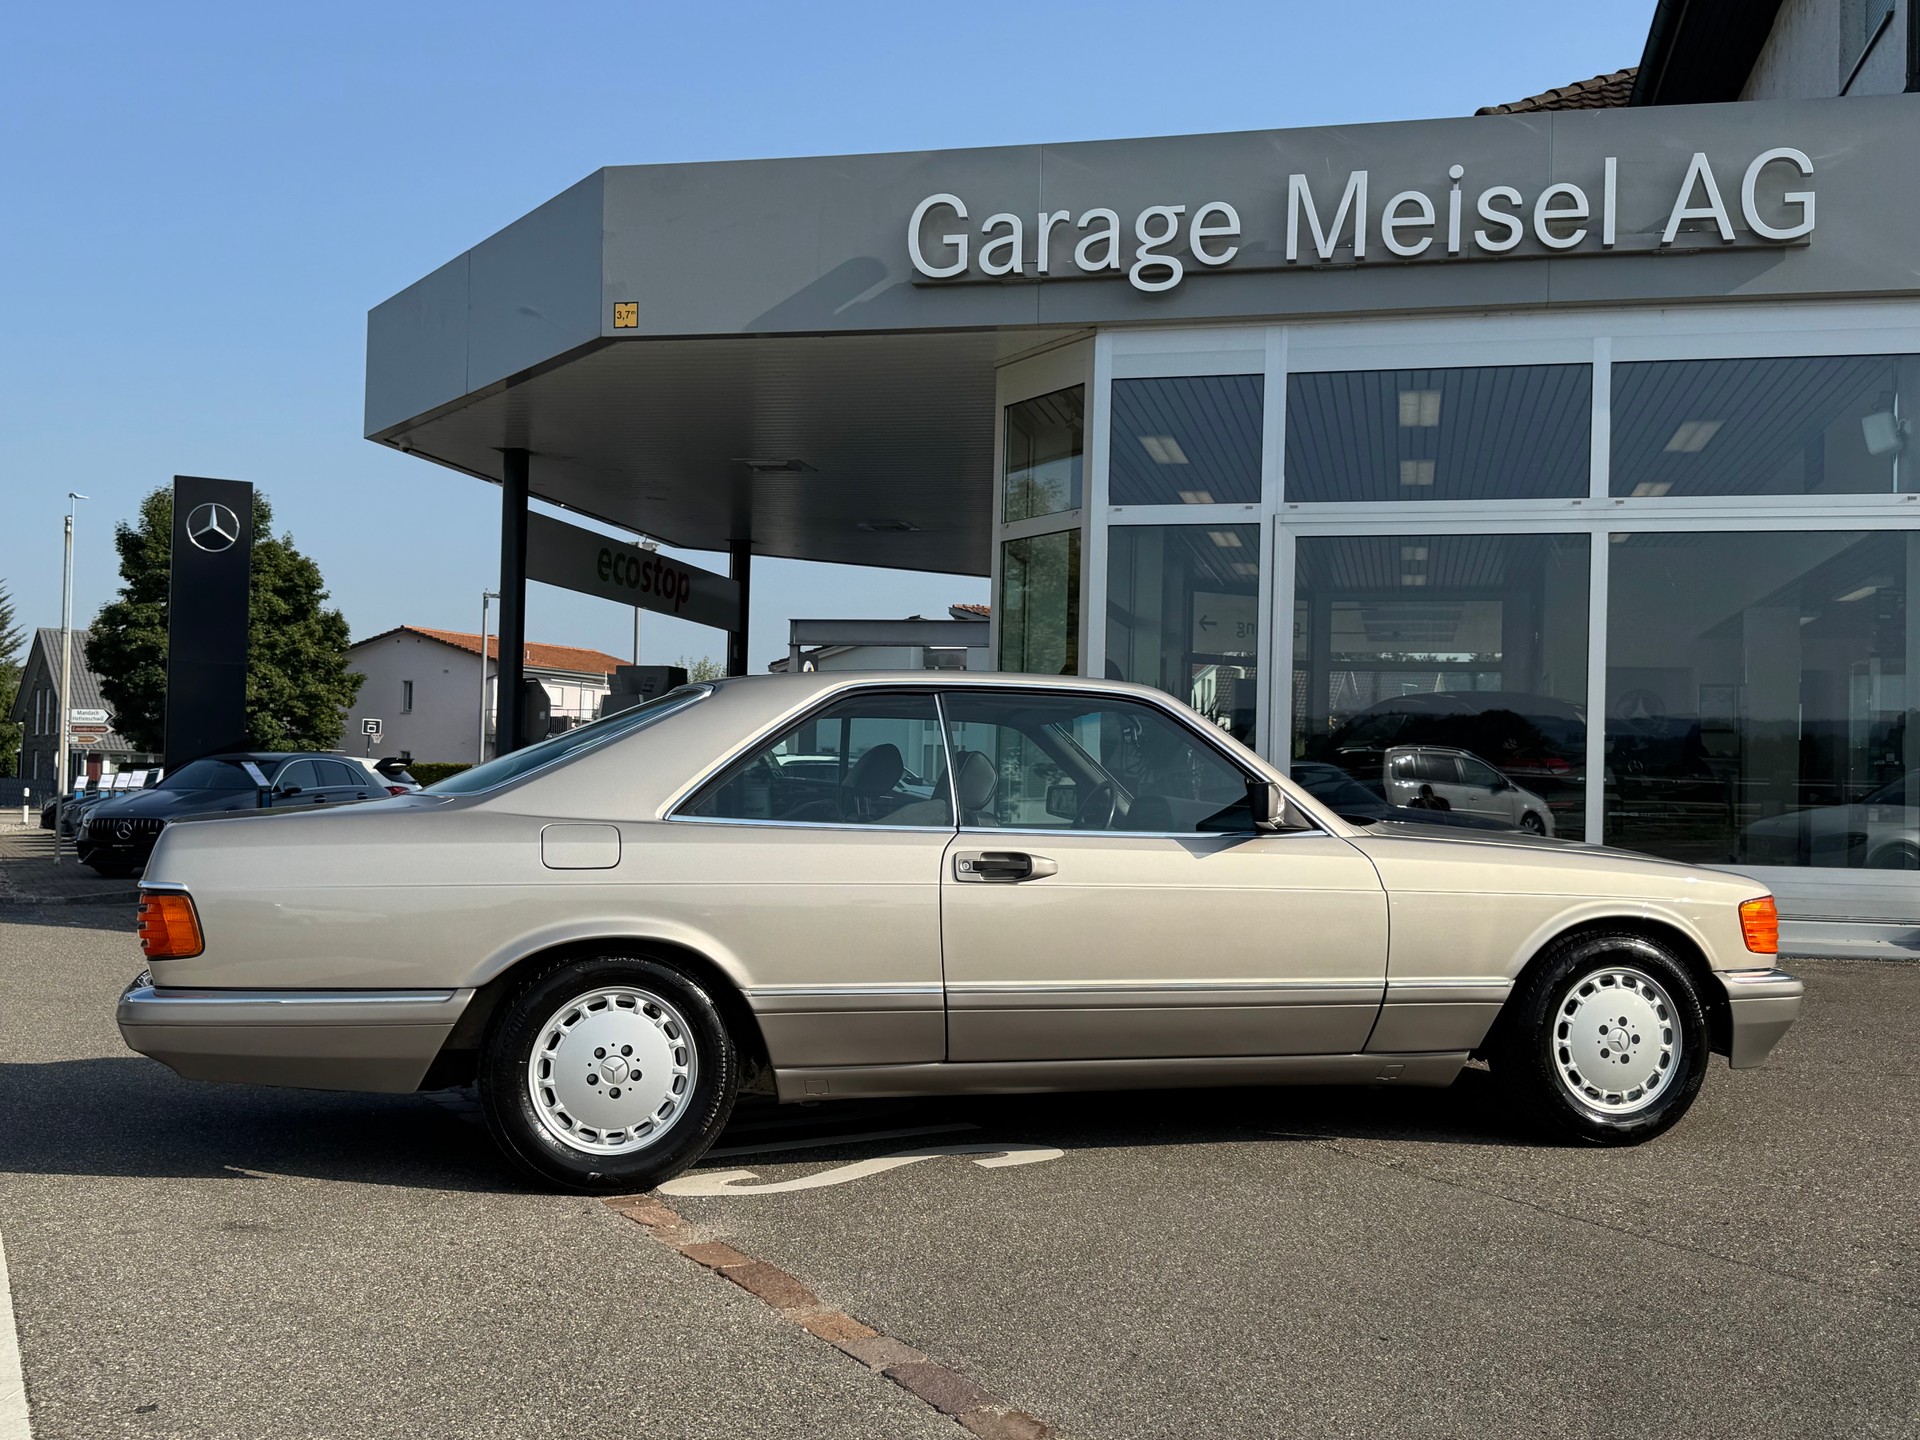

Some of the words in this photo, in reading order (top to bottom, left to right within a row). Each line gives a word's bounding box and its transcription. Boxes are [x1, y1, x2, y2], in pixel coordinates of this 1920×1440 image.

[907, 192, 1242, 293] Garage
[1285, 156, 1618, 264] Meisel
[1660, 147, 1817, 246] AG
[597, 547, 690, 613] ecostop
